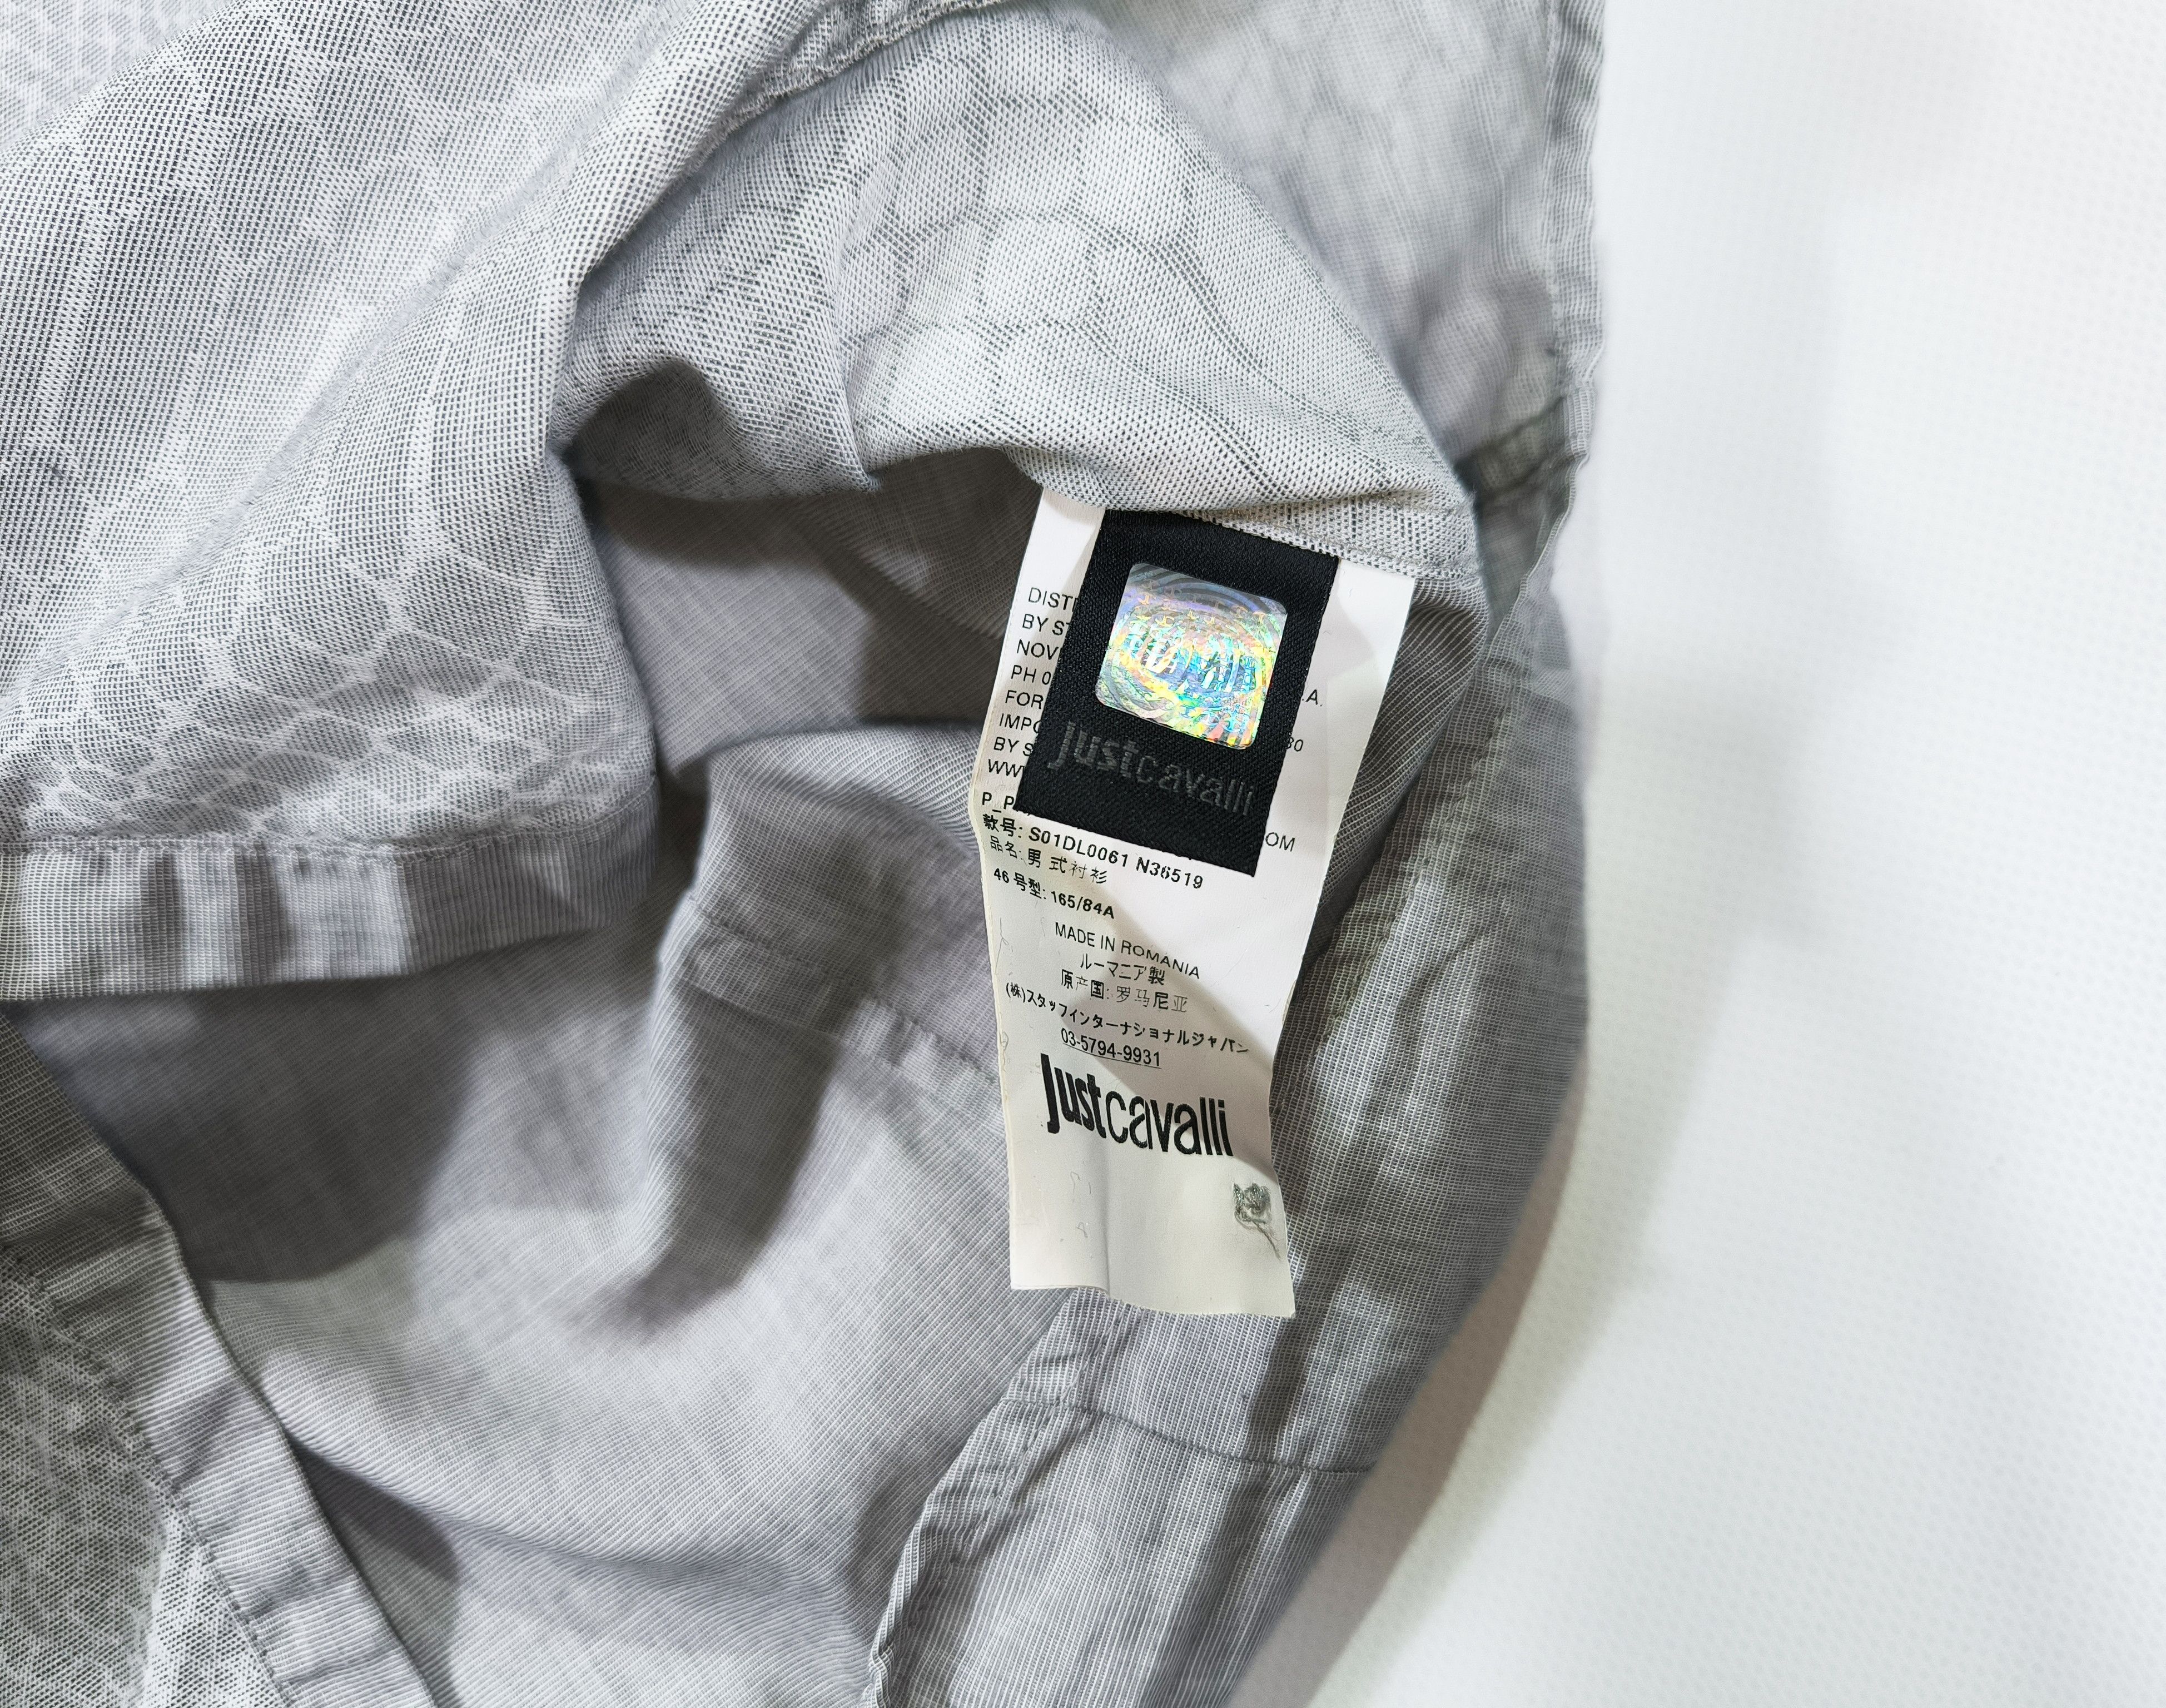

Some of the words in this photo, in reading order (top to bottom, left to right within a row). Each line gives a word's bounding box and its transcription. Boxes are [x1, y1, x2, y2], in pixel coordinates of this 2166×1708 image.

[1022, 613, 1049, 632] BY
[1011, 665, 1036, 683] PH
[1005, 690, 1044, 709] FOR
[993, 737, 1020, 752] BY
[1029, 827, 1128, 867] S01DL0061
[1136, 857, 1203, 889] N36519
[993, 868, 1009, 883] 46
[1051, 891, 1114, 919] 165/84A
[1055, 922, 1095, 947] MADE
[1101, 935, 1115, 951] IN
[1121, 940, 1200, 979] ROMANIA
[1080, 954, 1165, 985] ルーマニア製
[1061, 1027, 1161, 1066] 03-5794-9931
